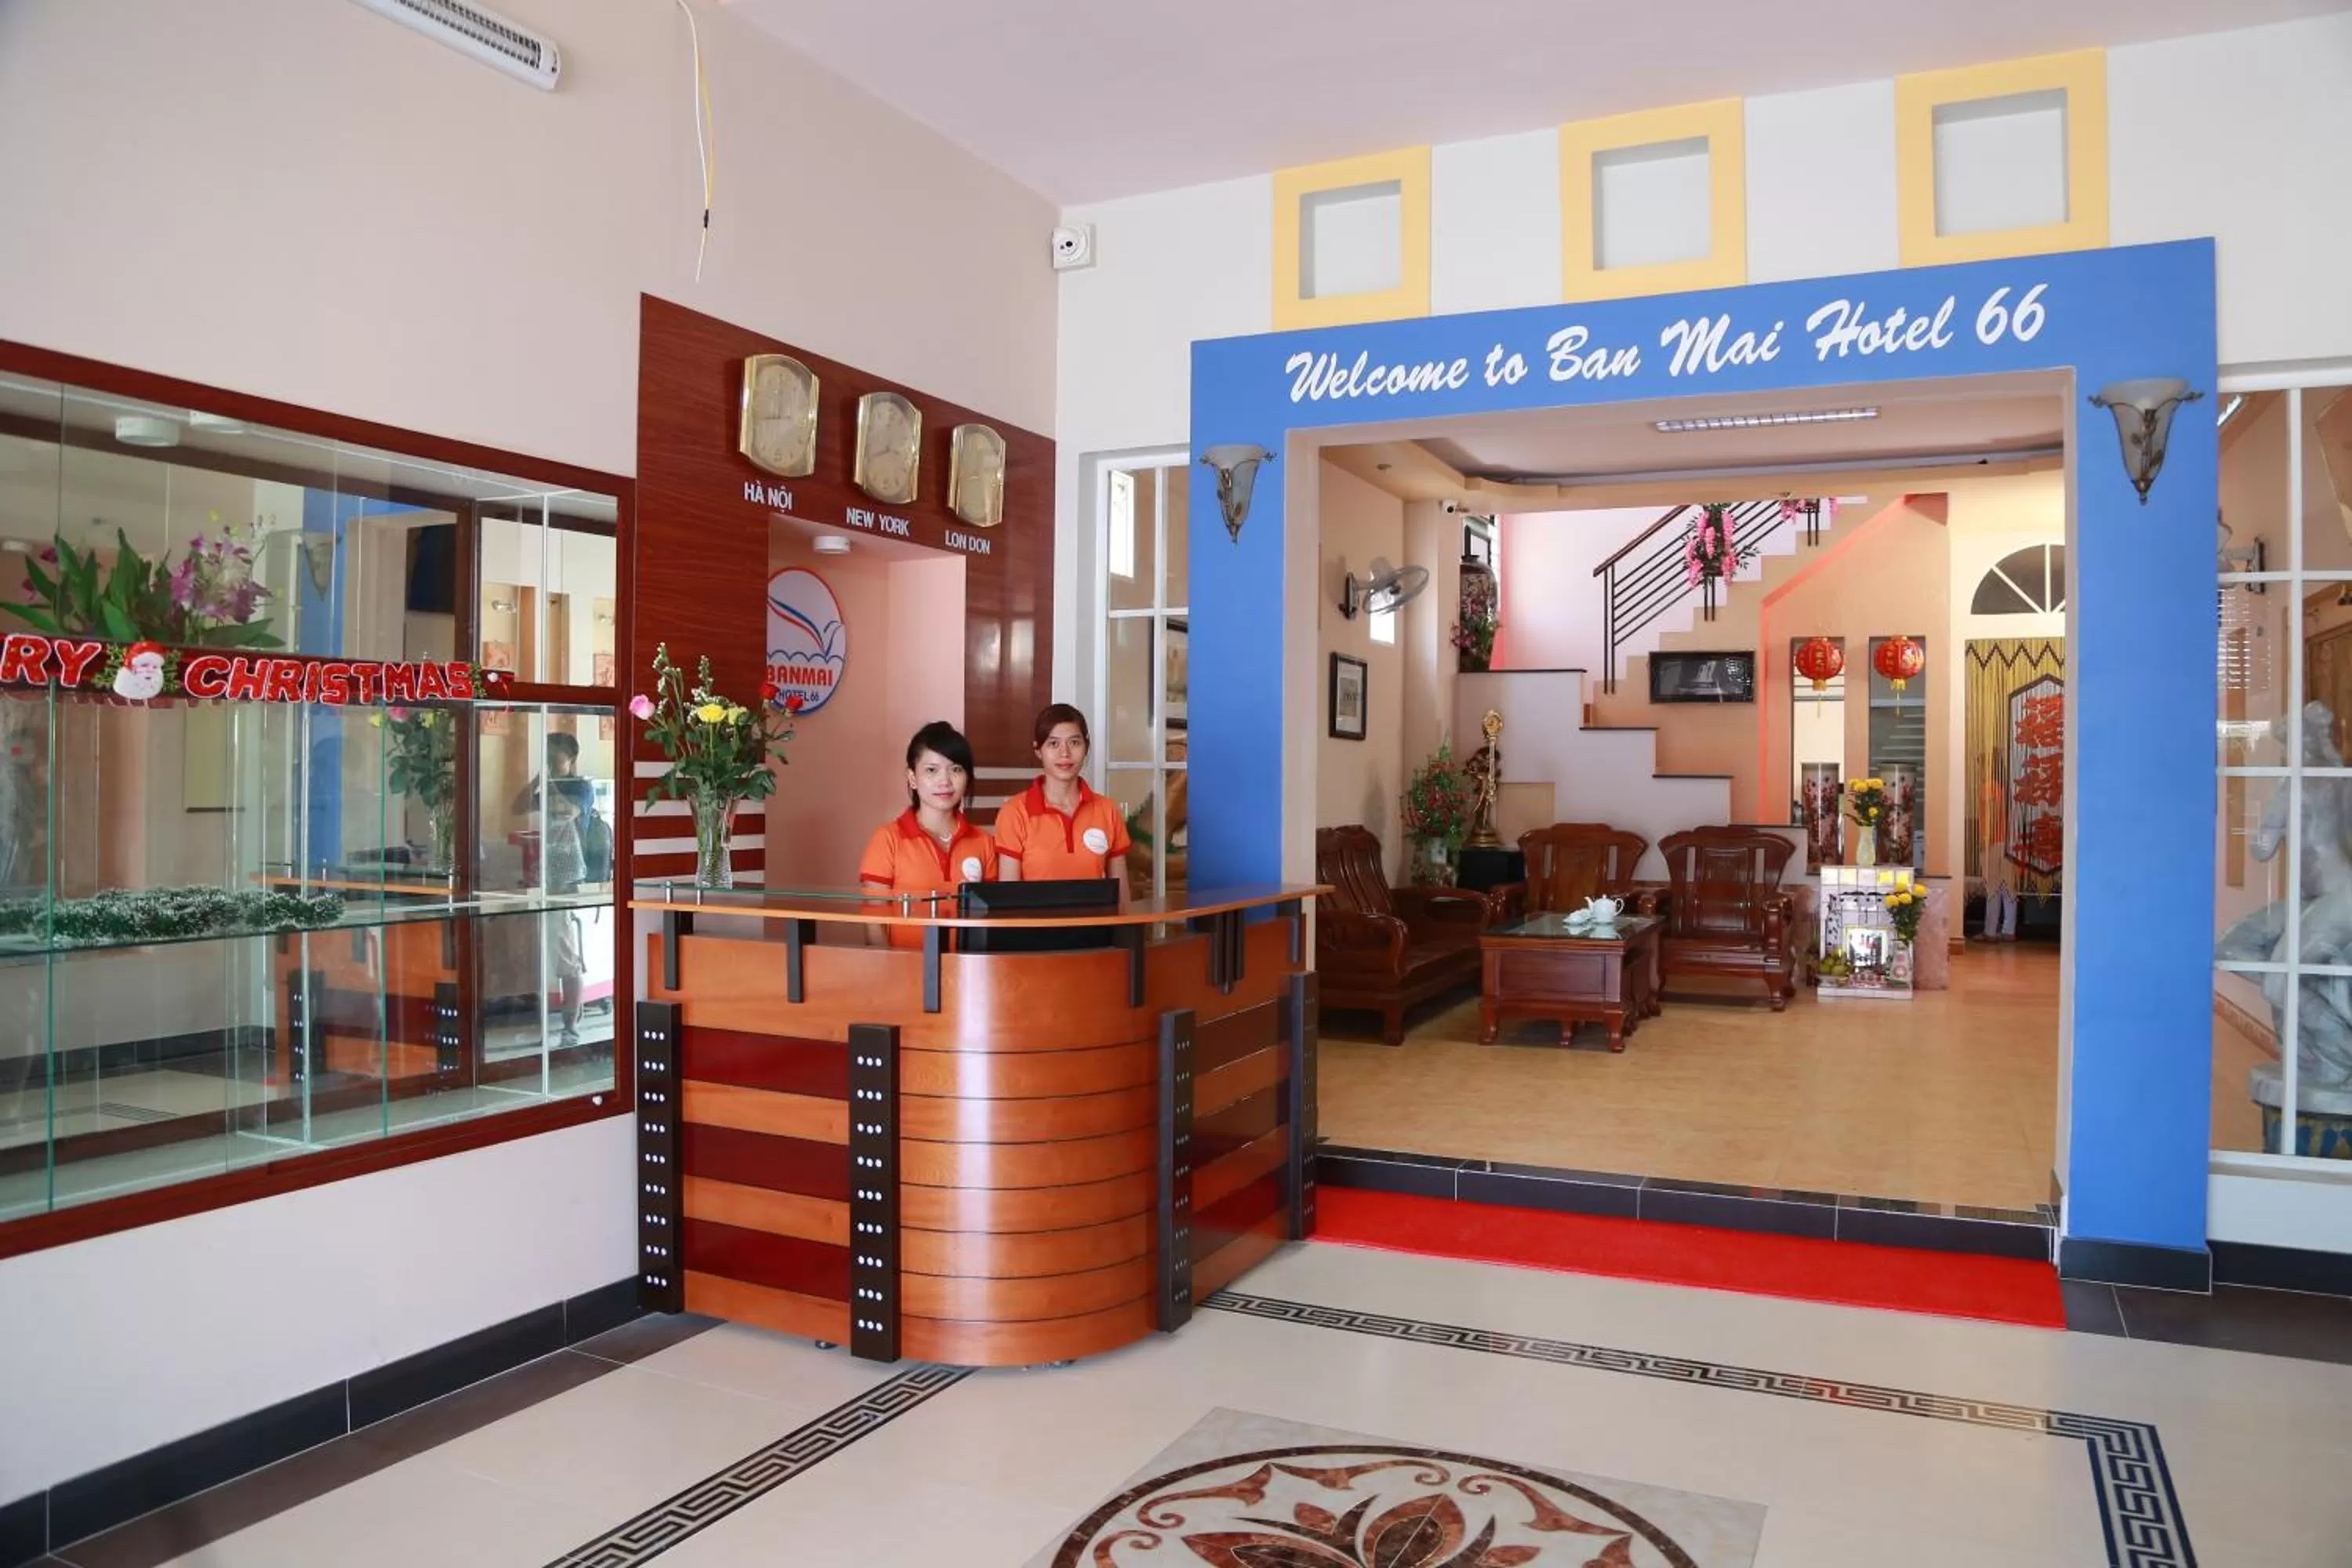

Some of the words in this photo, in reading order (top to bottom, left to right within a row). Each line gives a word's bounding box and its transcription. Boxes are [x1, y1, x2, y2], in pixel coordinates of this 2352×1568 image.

[1285, 350, 1469, 402] Welcome
[1483, 343, 1528, 387] to
[1545, 325, 1641, 382] Ban
[1661, 314, 1781, 377] Mai
[1806, 296, 1956, 361] Hotel
[1976, 283, 2048, 345] 66
[744, 481, 765, 504] HÀ
[768, 485, 793, 514] NỘI
[846, 506, 875, 528] NEW
[878, 513, 909, 537] YORK
[183, 655, 475, 705] CHRISTMAS
